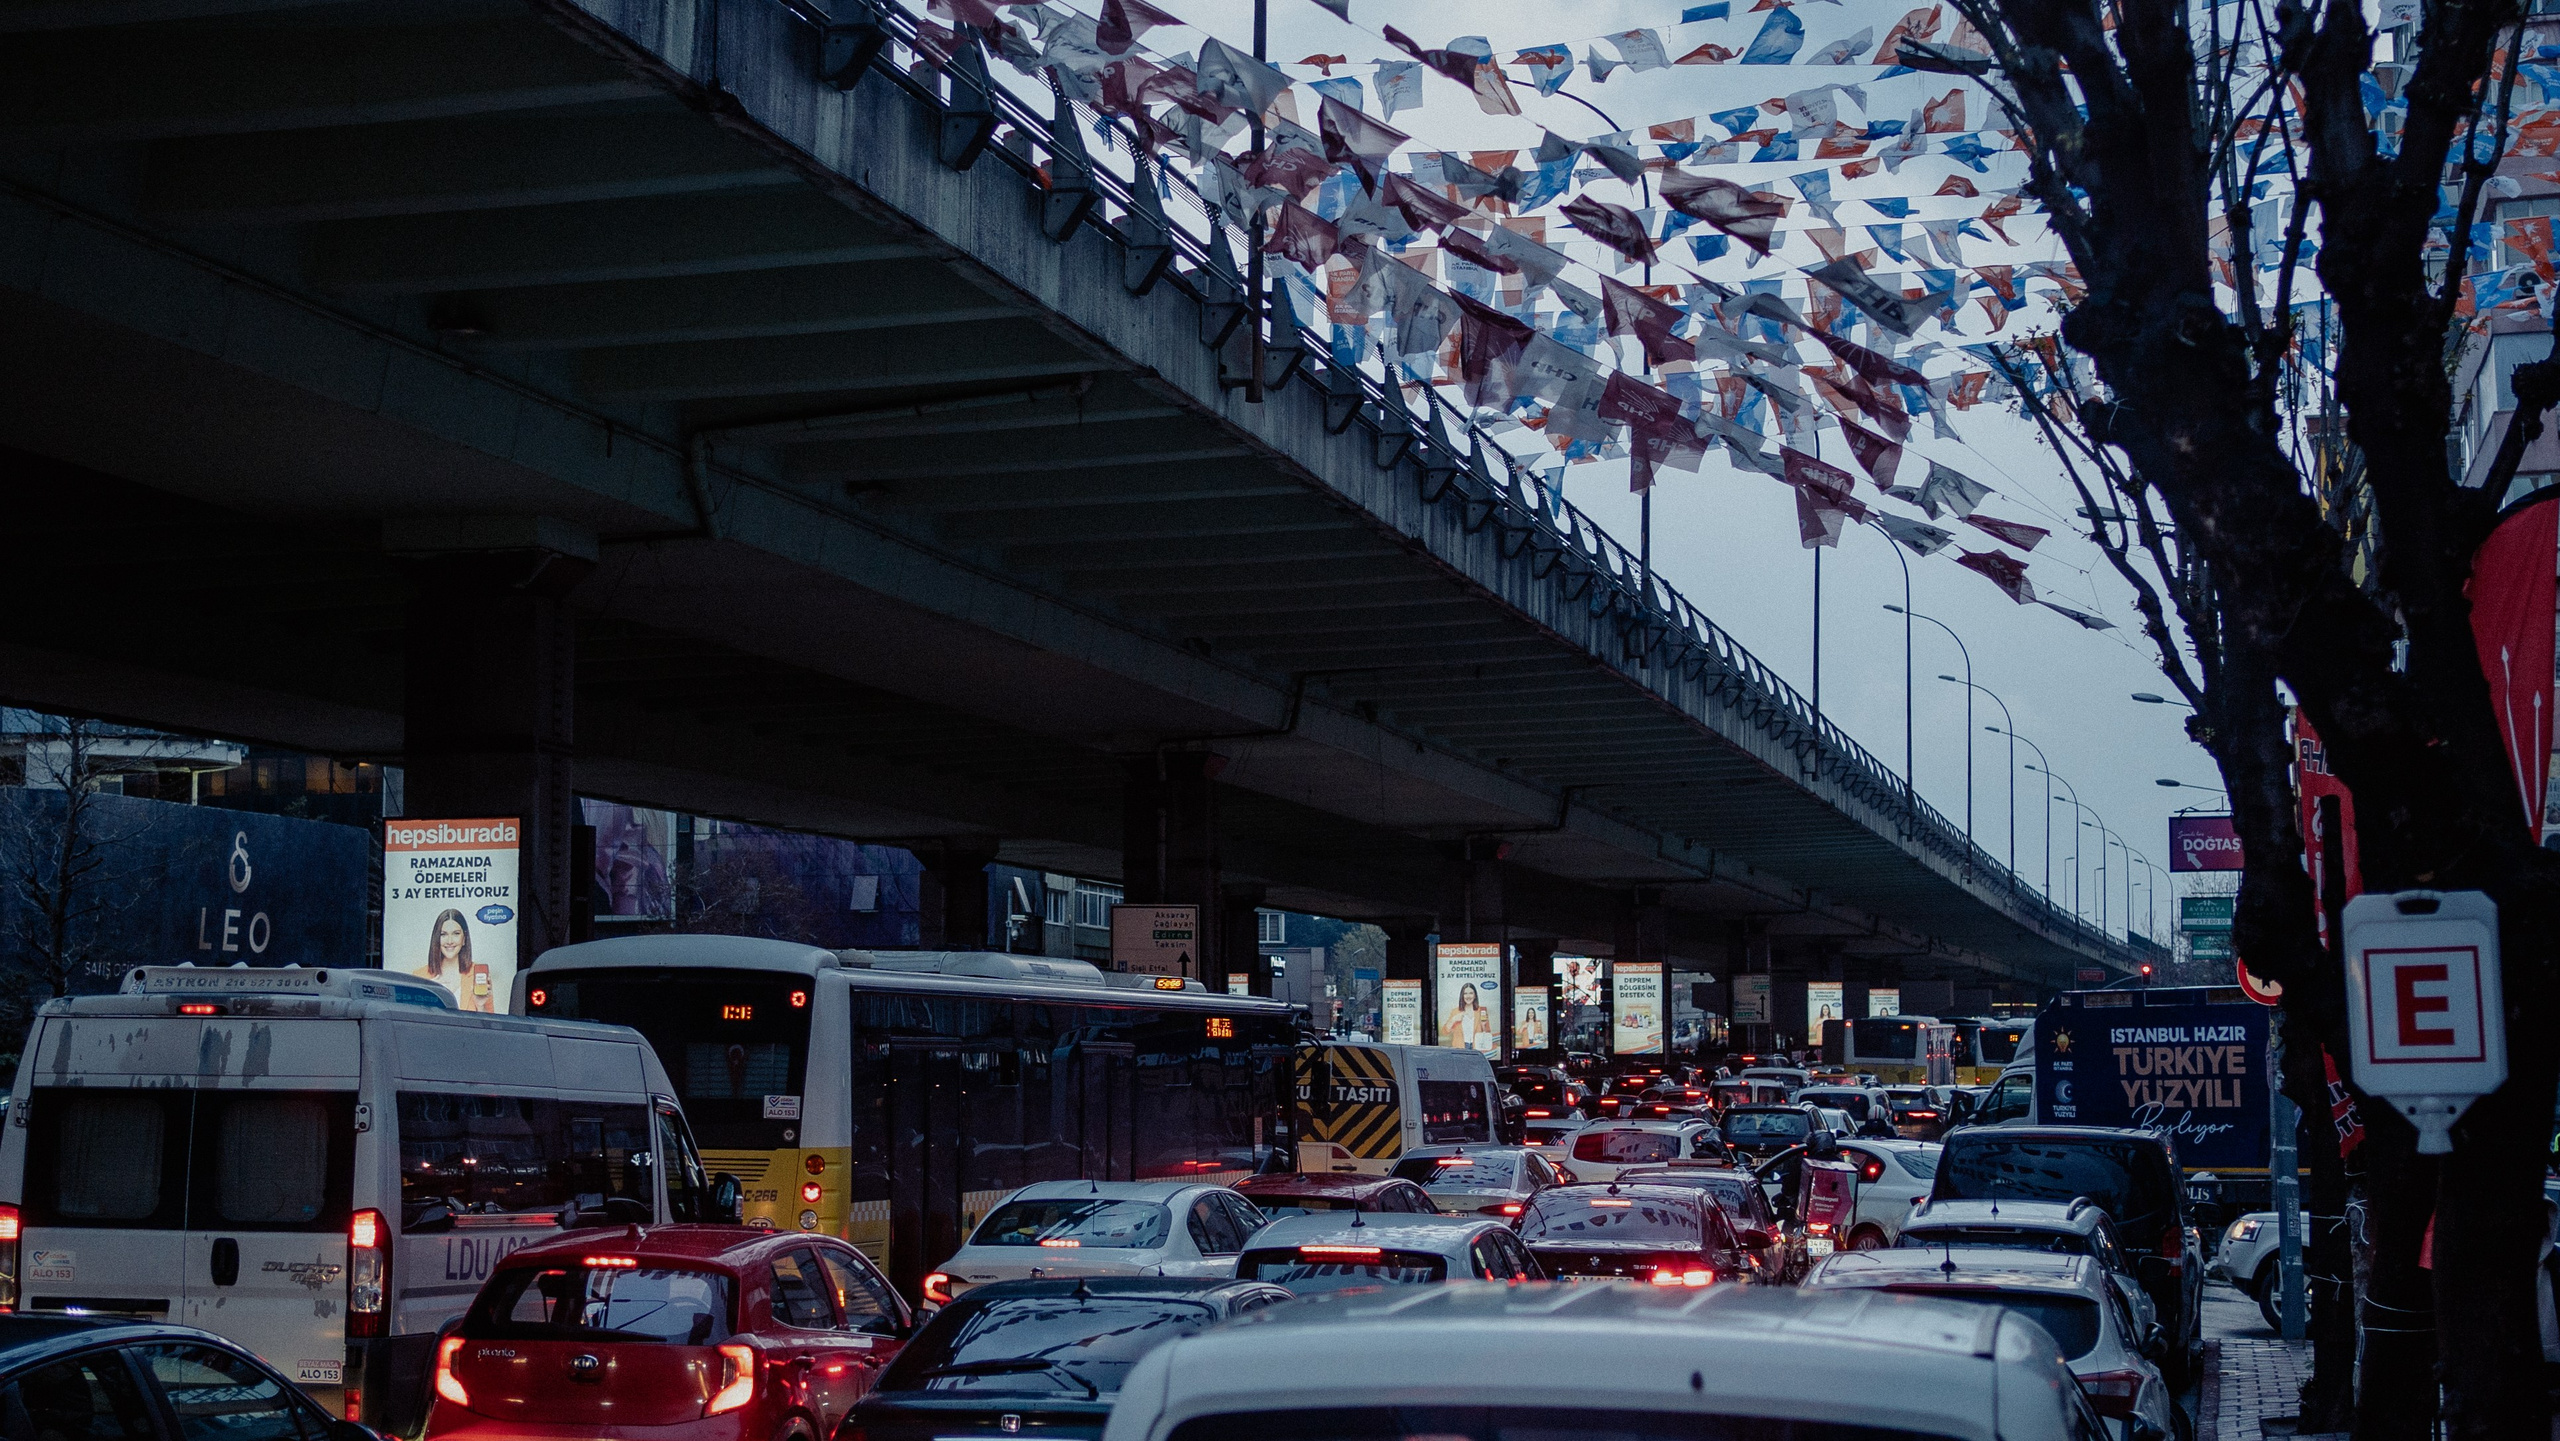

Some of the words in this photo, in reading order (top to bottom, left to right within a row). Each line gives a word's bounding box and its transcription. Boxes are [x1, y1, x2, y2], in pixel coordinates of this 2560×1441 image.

[387, 822, 517, 849] hepsiburada
[2183, 836, 2242, 852] DOĞTAŞ
[410, 856, 492, 869] RAMAZANDA
[414, 868, 487, 884] ÖDEMELERİ
[392, 888, 400, 899] 3
[405, 887, 421, 899] AY
[425, 884, 509, 899] ERTELİYORUZ
[1155, 912, 1190, 920] Aksaray
[199, 907, 271, 954] LEO
[1154, 920, 1194, 928] Çağlayan
[1438, 945, 1499, 957] hepsiburada
[2395, 964, 2455, 1047] E
[2193, 1026, 2246, 1042] HAZIR
[1336, 1086, 1391, 1104] TAŞITI
[446, 1238, 489, 1281] LDU
[33, 1268, 53, 1278] ALO
[56, 1270, 71, 1279] 153
[261, 1261, 342, 1274] DUCATO
[574, 1360, 594, 1368] KIA
[300, 1370, 321, 1379] ALO
[323, 1370, 339, 1379] 153
